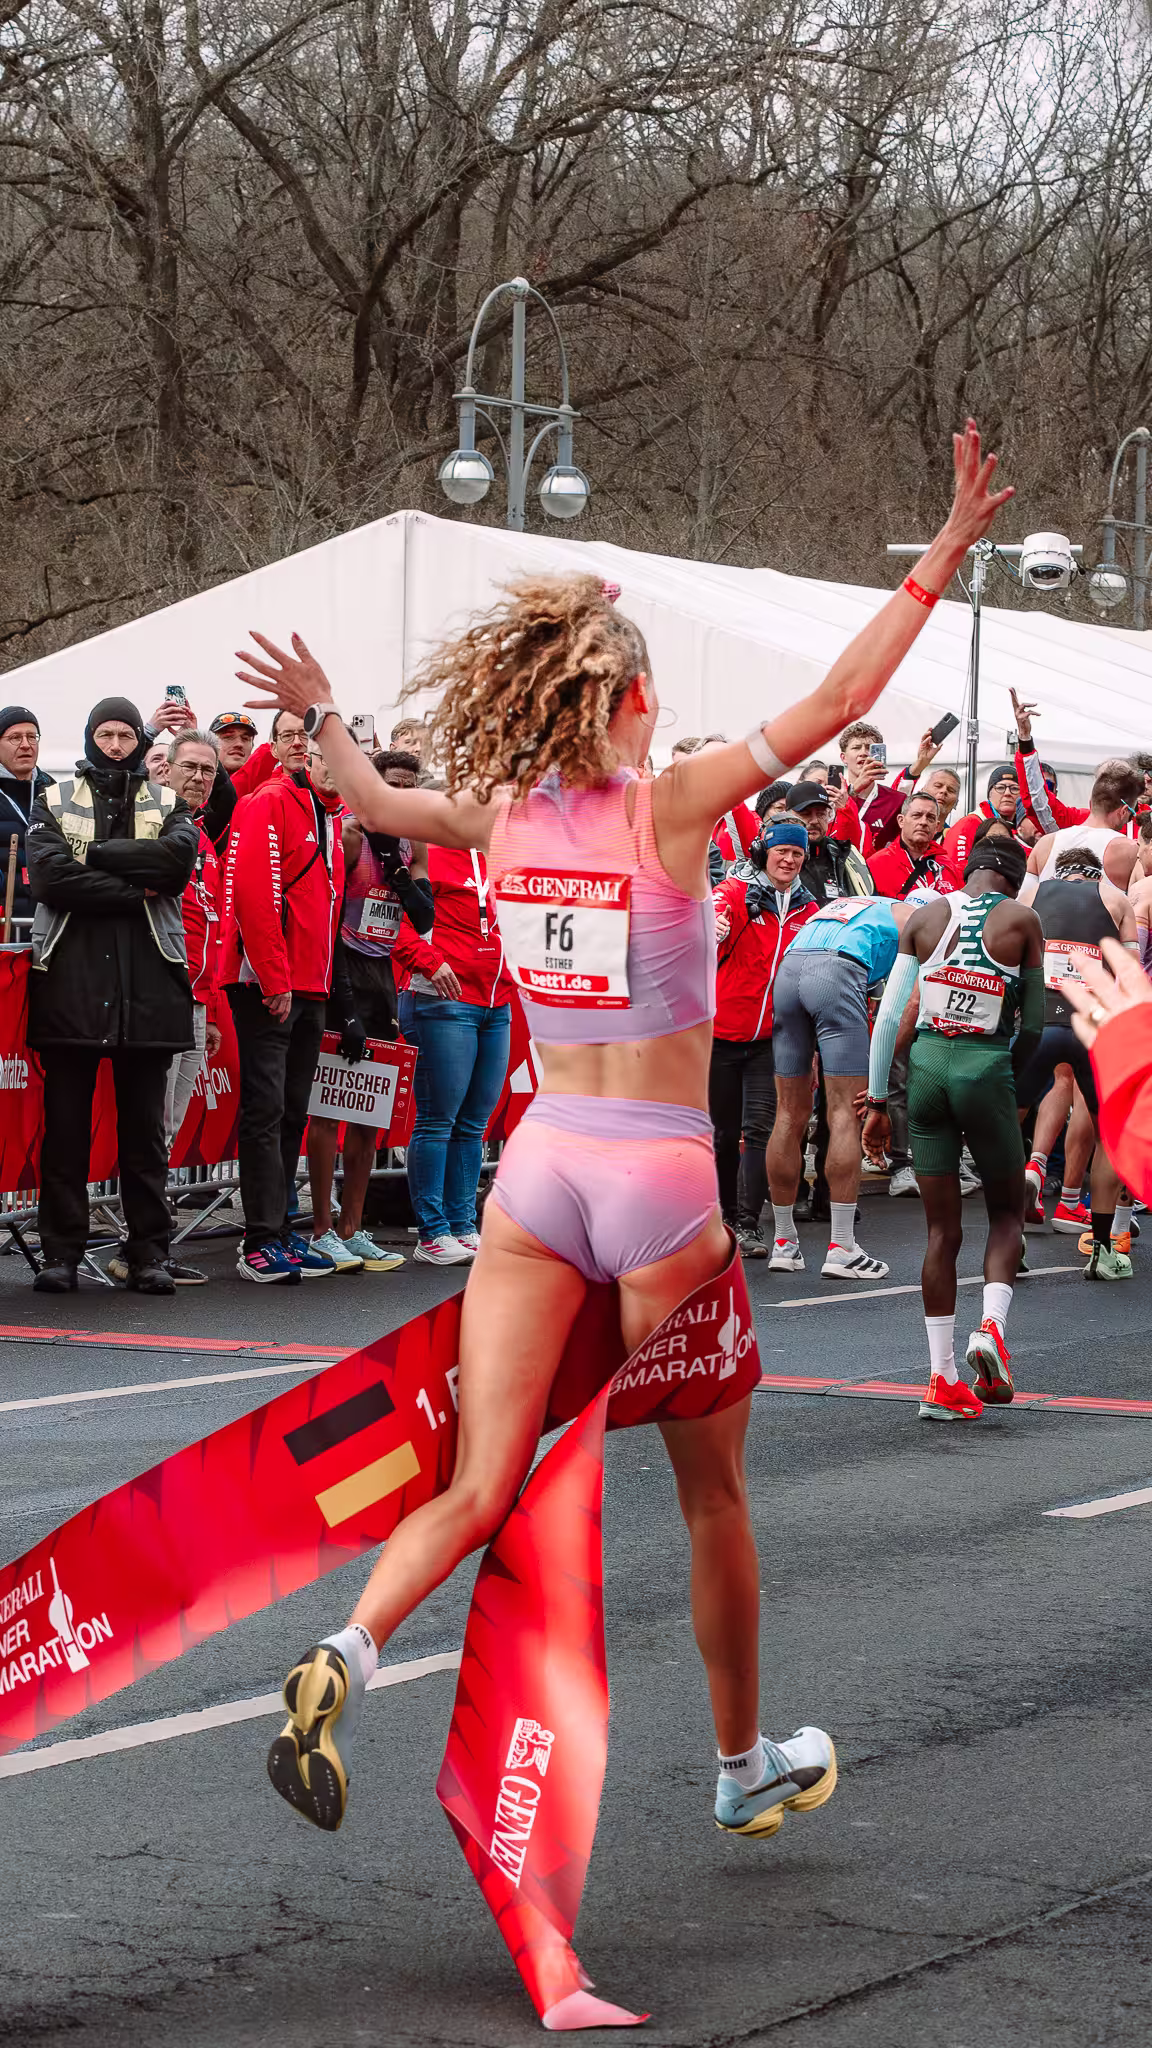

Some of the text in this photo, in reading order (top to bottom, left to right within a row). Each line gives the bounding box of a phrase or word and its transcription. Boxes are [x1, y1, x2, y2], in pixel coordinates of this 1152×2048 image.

[527, 876, 621, 902] GENERALI
[545, 912, 574, 952] F6
[545, 956, 573, 970] ESTHER
[529, 971, 592, 990] bett1.de
[947, 971, 1000, 992] GENERALI
[946, 990, 977, 1015] F22
[320, 1085, 376, 1113] REKORD
